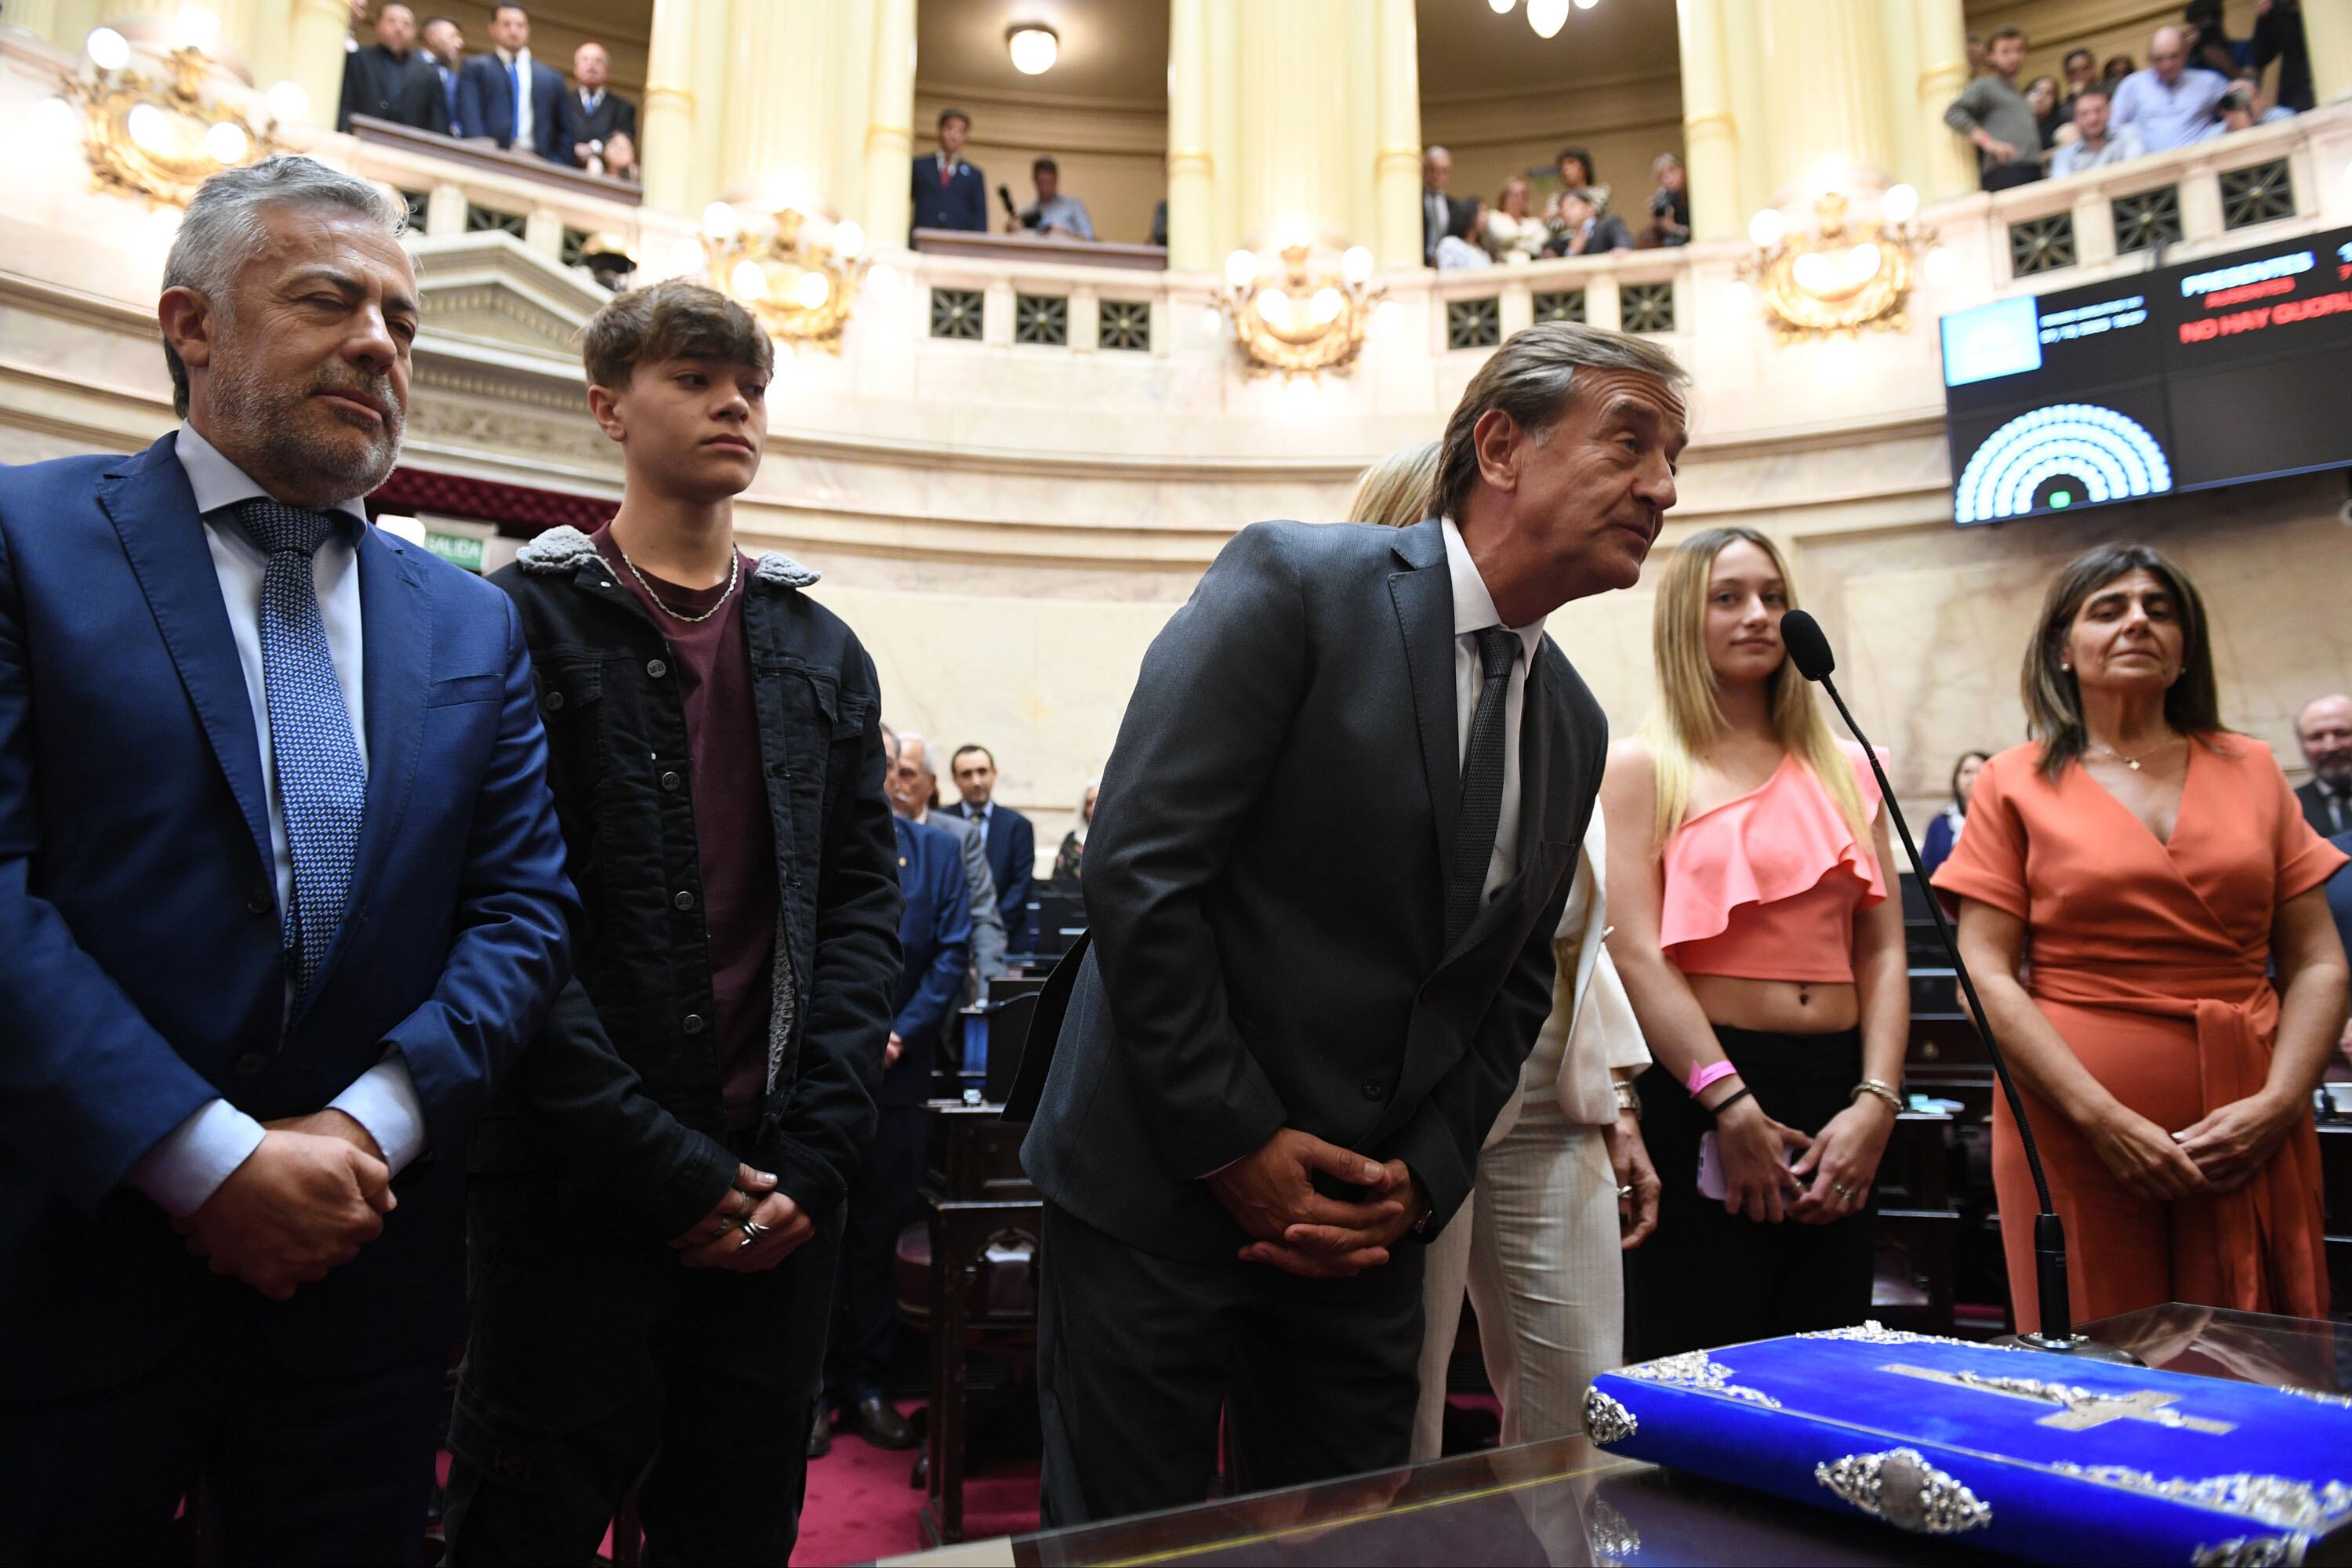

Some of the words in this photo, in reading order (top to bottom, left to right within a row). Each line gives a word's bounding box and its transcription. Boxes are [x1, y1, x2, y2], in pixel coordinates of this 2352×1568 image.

[2179, 318, 2219, 344] NO
[2219, 307, 2271, 336] HAY
[426, 534, 480, 558] SALIDA
